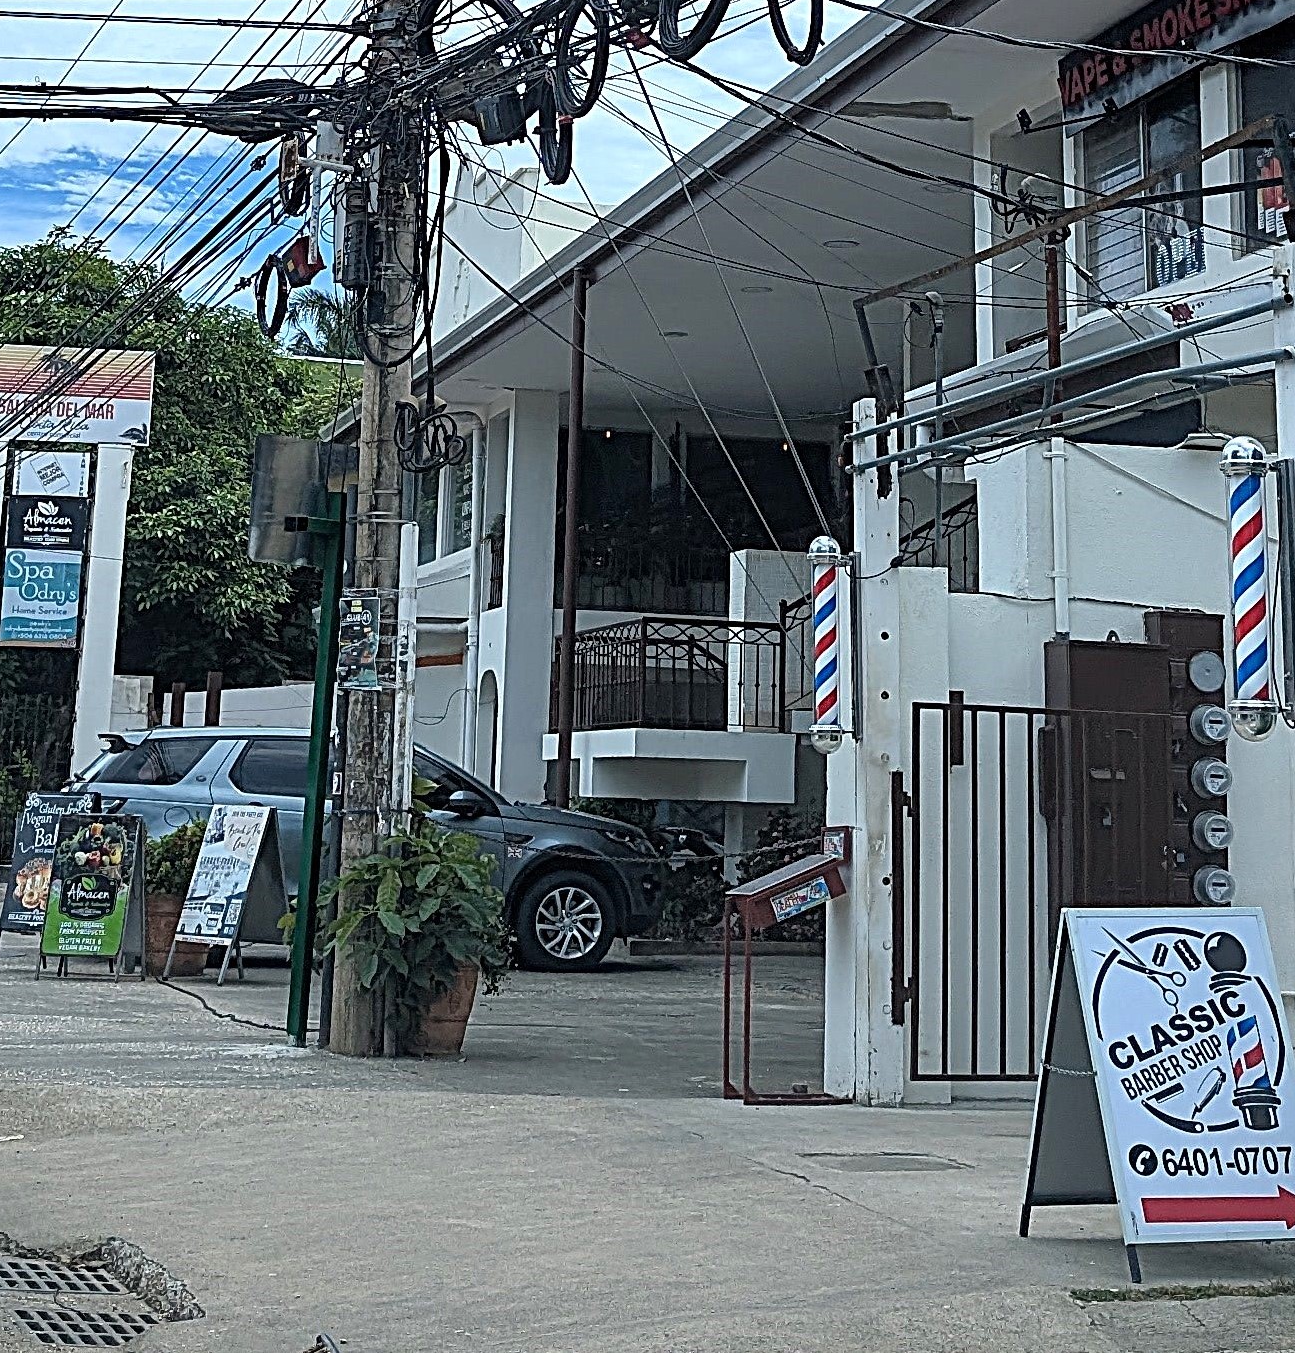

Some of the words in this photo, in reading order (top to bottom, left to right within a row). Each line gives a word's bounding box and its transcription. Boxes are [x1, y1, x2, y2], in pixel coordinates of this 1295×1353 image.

[1057, 54, 1109, 107] VAPE
[56, 401, 81, 418] DEL
[84, 403, 115, 420] MAR
[7, 552, 55, 584] Spa
[21, 581, 77, 604] Odry's
[11, 605, 36, 615] Home
[38, 605, 68, 615] Service
[26, 812, 53, 828] Vegan
[1108, 989, 1246, 1071] CLASSIC
[1120, 1054, 1186, 1101] BARBER
[1180, 1033, 1223, 1071] SHOP
[1162, 1145, 1292, 1177] 6401-0707
